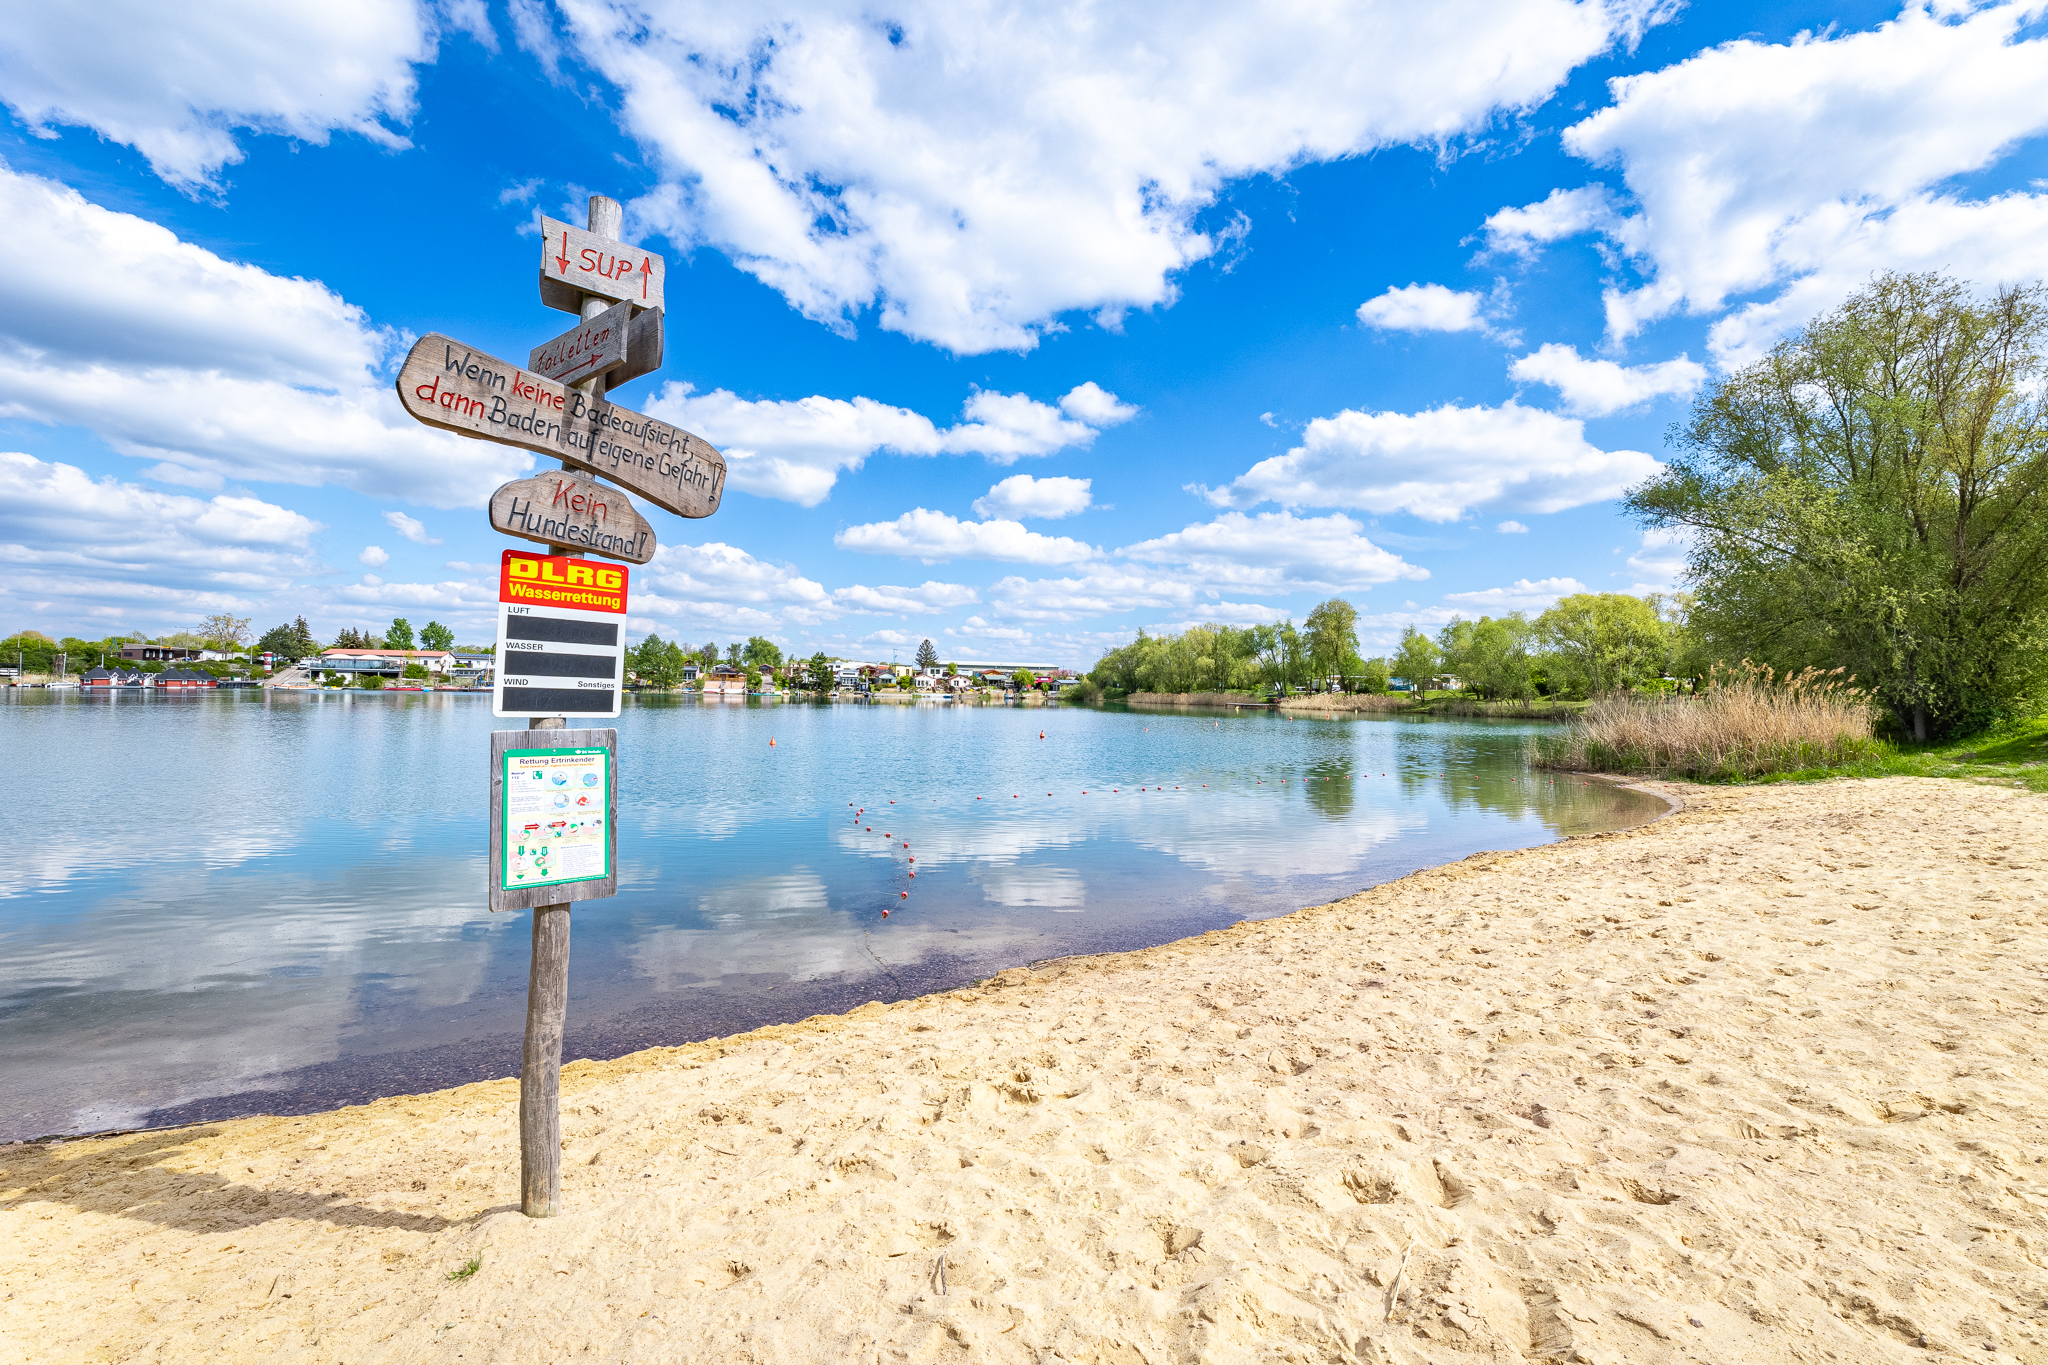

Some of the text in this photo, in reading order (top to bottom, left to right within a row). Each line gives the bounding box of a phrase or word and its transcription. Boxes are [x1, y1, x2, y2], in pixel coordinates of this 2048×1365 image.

[579, 249, 632, 281] SUP
[537, 328, 610, 375] Toiletten
[445, 345, 694, 462] Wenn keine Badeaufsicht,
[415, 376, 485, 420] dann
[487, 395, 561, 442] Baden
[567, 428, 599, 459] auf
[599, 439, 654, 470] eigene
[552, 480, 608, 520] Kein
[507, 496, 649, 559] Hundestrand!
[509, 557, 622, 589] DLRG
[507, 606, 531, 615] LUFT
[508, 582, 621, 610] Wasserrettung
[505, 642, 544, 651] WASSER
[503, 678, 529, 686] WIND
[577, 680, 615, 689] Sonstiges
